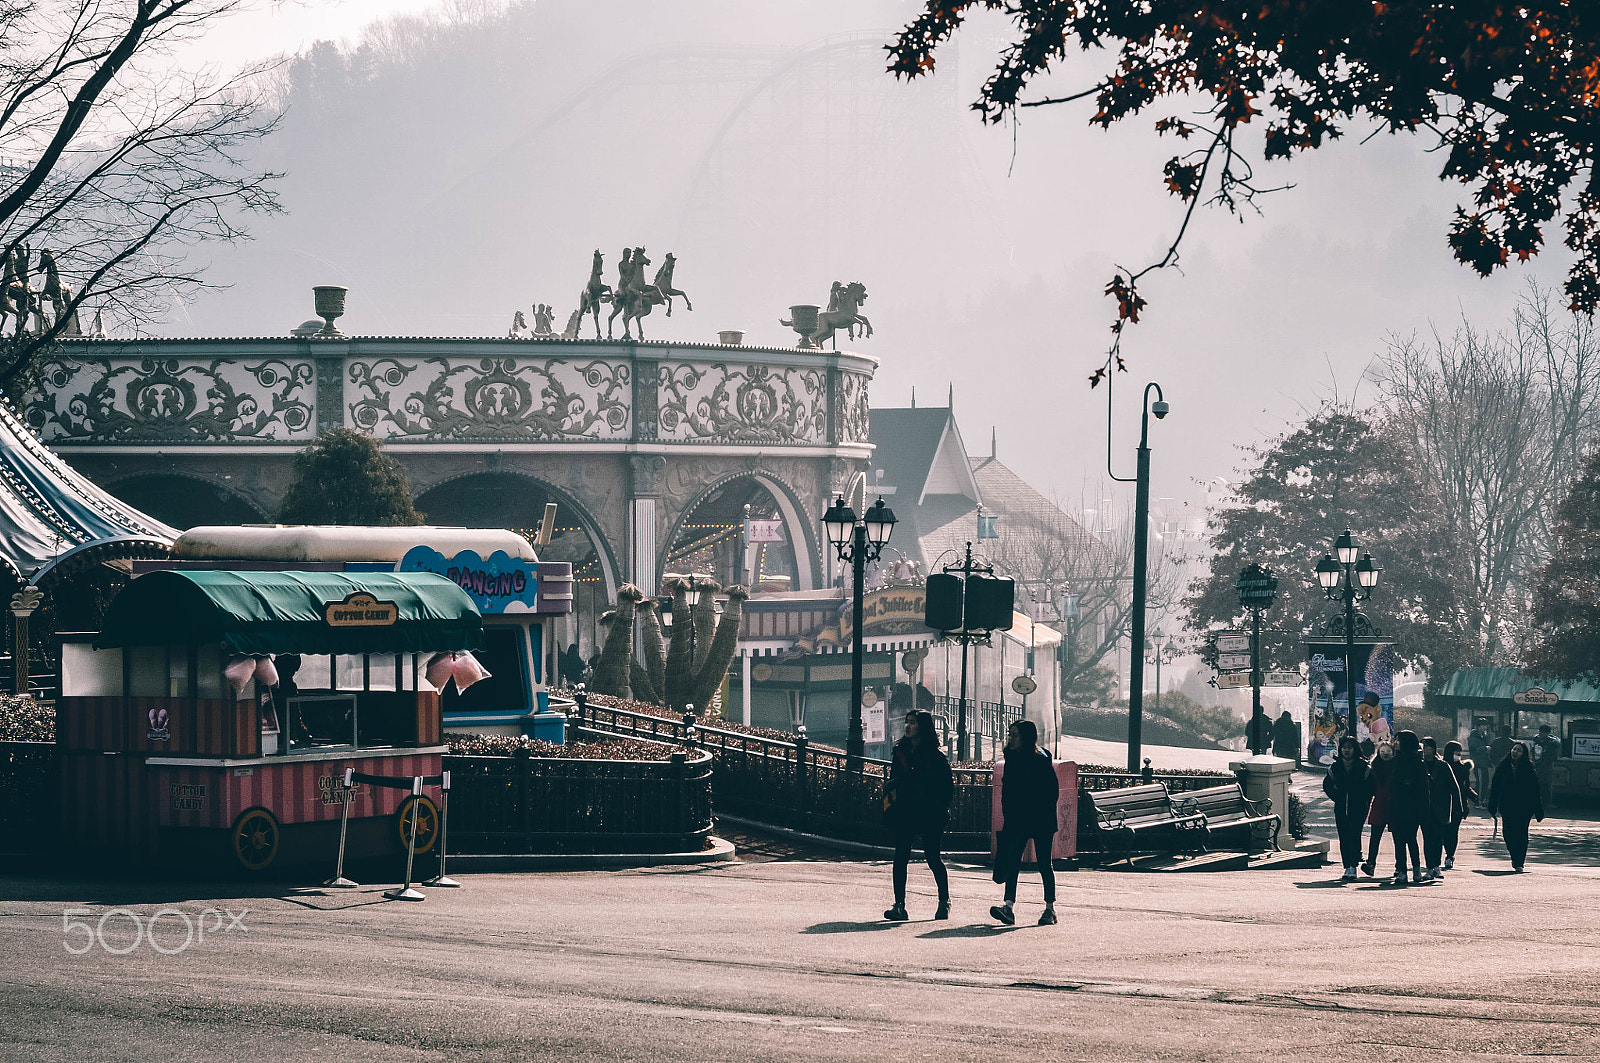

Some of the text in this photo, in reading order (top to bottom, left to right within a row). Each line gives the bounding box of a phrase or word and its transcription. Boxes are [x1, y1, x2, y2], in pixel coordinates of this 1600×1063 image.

[447, 566, 527, 598] DANCING
[1238, 588, 1274, 598] Adventure
[364, 610, 390, 620] CANDY
[1524, 694, 1549, 703] Snack
[170, 783, 206, 797] COTTON
[173, 797, 204, 811] CANDY
